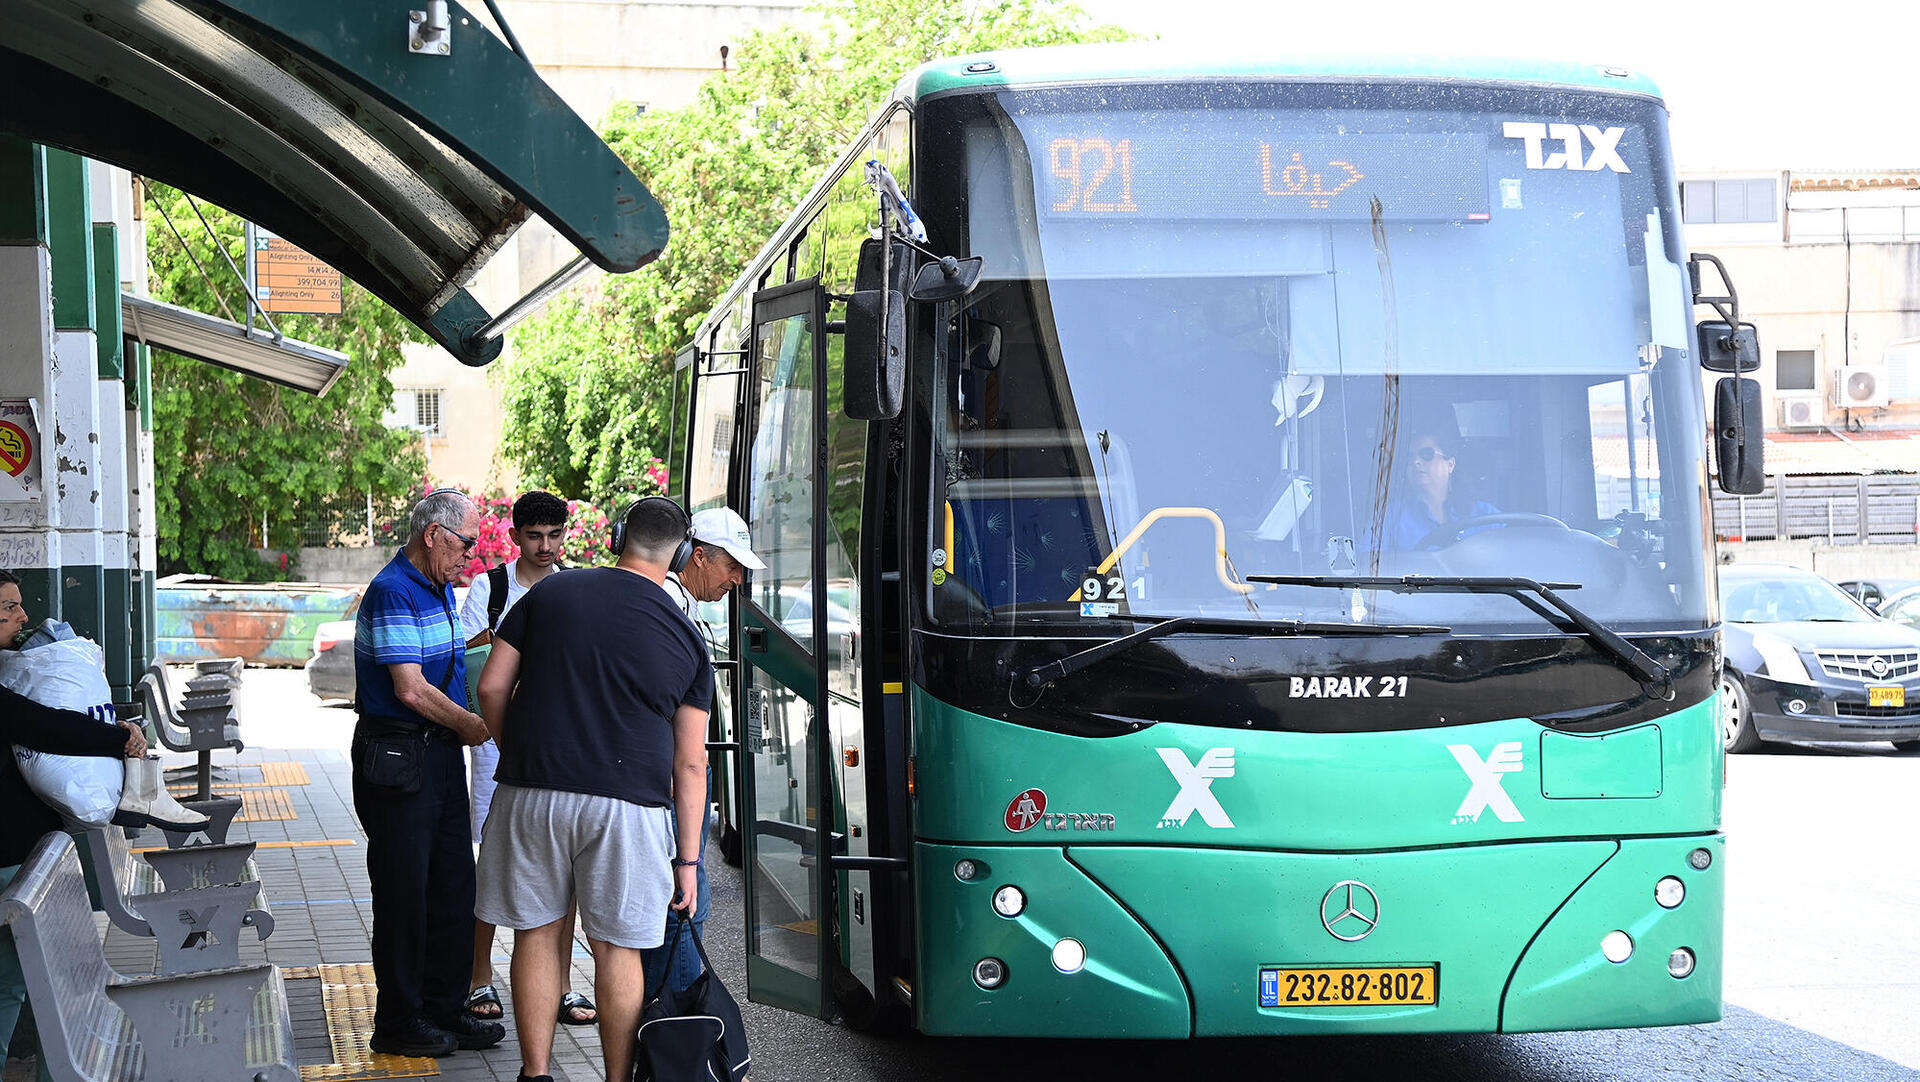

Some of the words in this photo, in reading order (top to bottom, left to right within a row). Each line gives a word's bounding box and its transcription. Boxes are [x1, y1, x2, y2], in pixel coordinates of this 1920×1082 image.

[1502, 121, 1632, 173] אגד
[1049, 138, 1138, 213] 921
[1260, 143, 1365, 208] حيفا
[269, 253, 298, 261] Alighting
[270, 290, 299, 298] Alighting
[299, 291, 315, 299] Only
[1083, 576, 1146, 601] 921
[1289, 676, 1374, 698] BARAK
[1377, 676, 1409, 698] 21
[1044, 812, 1116, 831] הארגז
[1265, 981, 1277, 995] IL
